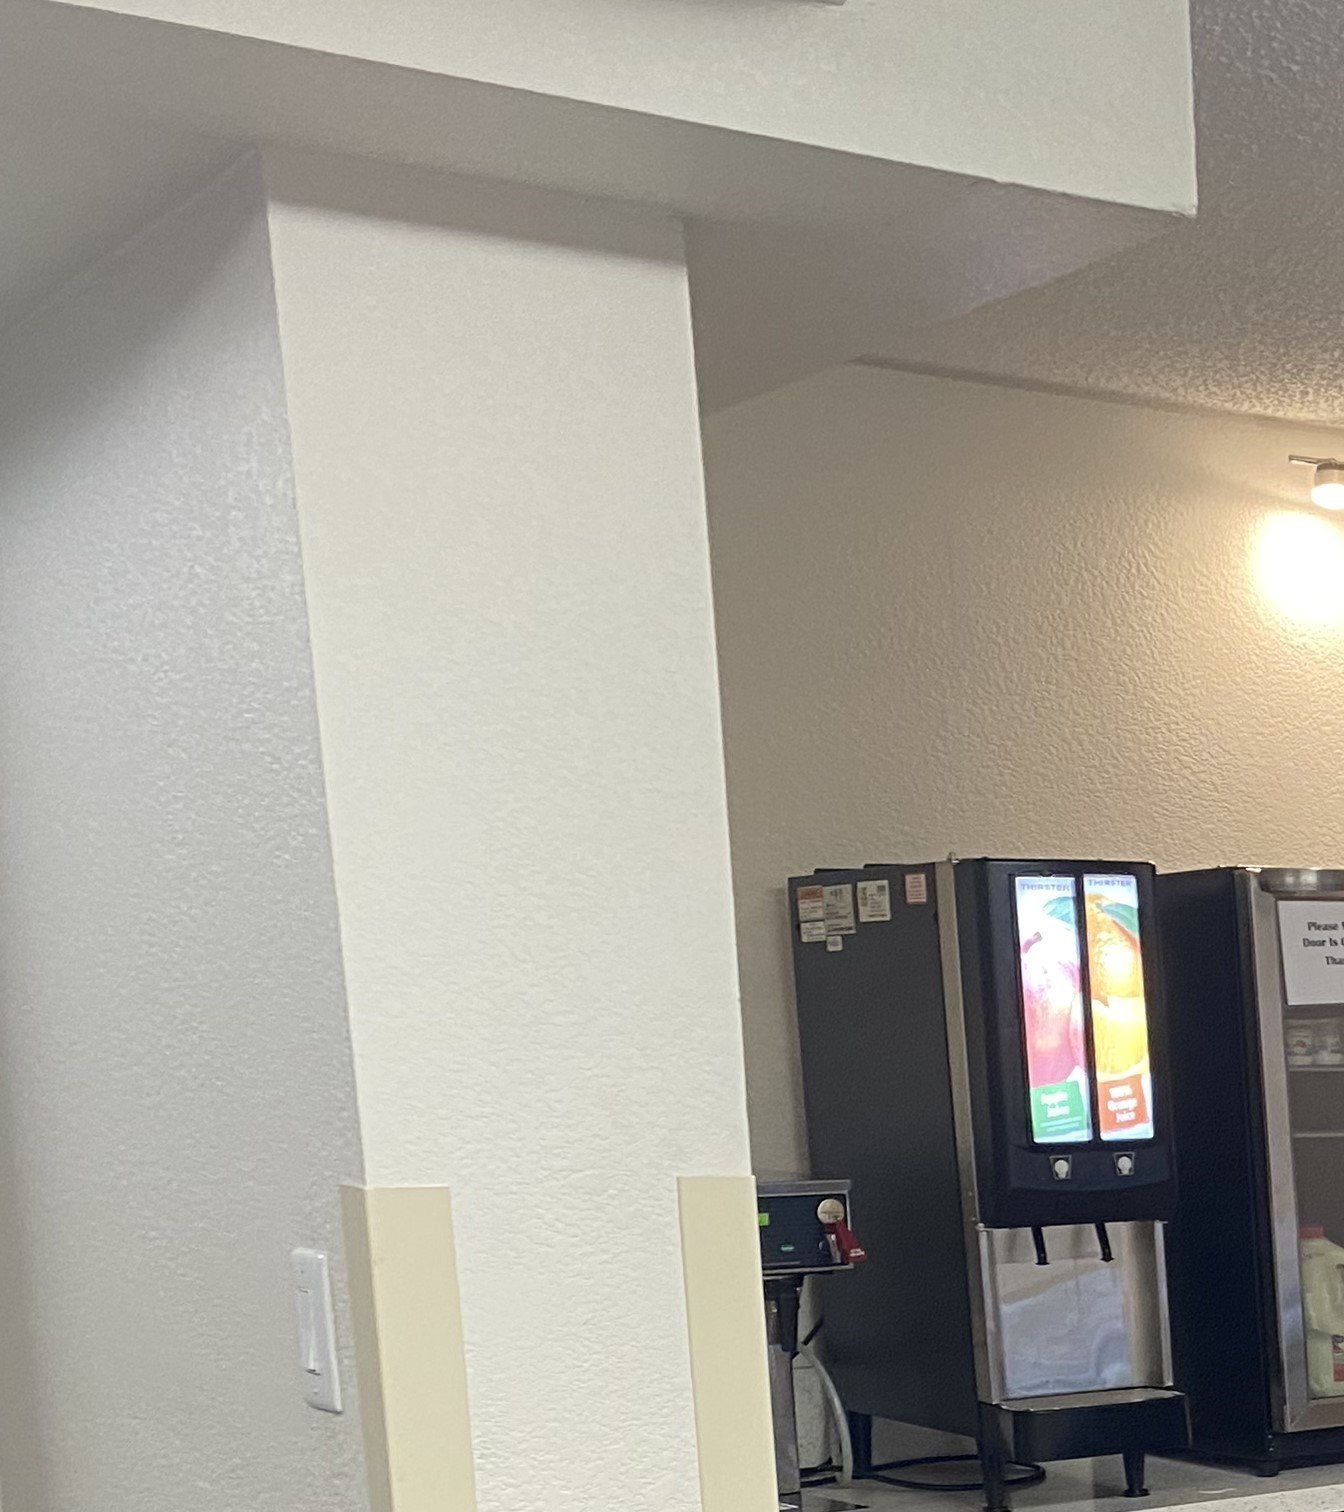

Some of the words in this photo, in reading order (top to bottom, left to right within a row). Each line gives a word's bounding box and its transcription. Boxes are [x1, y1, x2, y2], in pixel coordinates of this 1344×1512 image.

[1088, 879, 1133, 887] THIRSTER
[1307, 921, 1339, 931] Please
[1303, 937, 1326, 947] Door
[1329, 937, 1338, 946] Is
